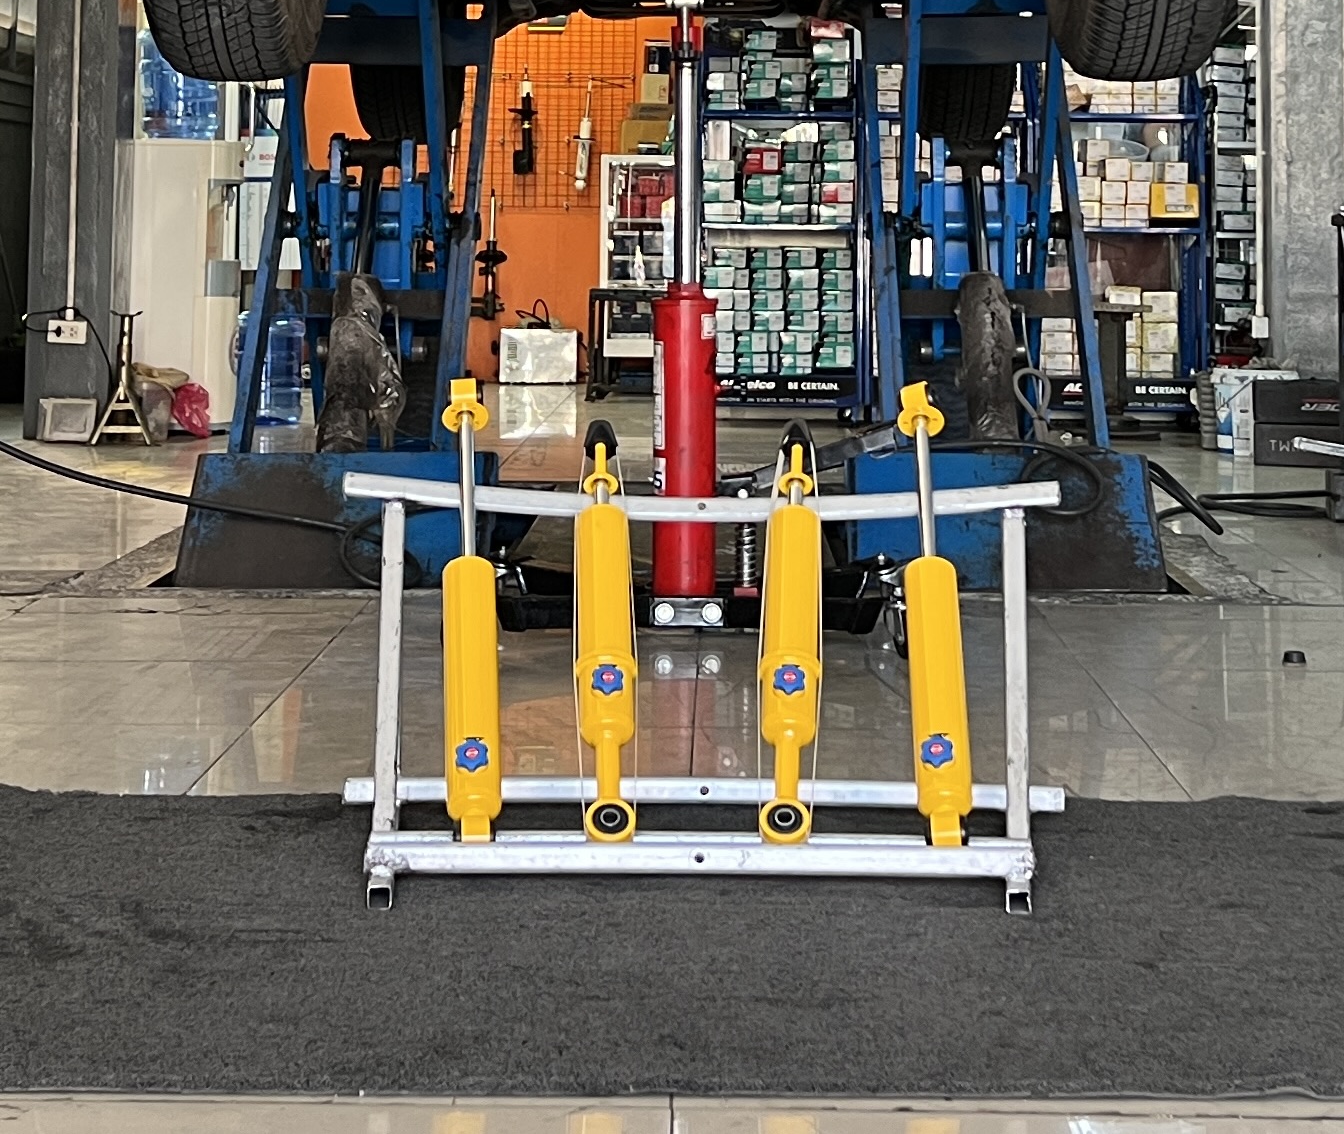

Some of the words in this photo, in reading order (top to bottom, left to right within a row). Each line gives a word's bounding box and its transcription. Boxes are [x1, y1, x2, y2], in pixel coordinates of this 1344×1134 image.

[787, 381, 799, 390] BE
[800, 382, 840, 391] CERTAIN.
[1135, 385, 1147, 394] BE
[1148, 385, 1188, 395] CERTAIN.
